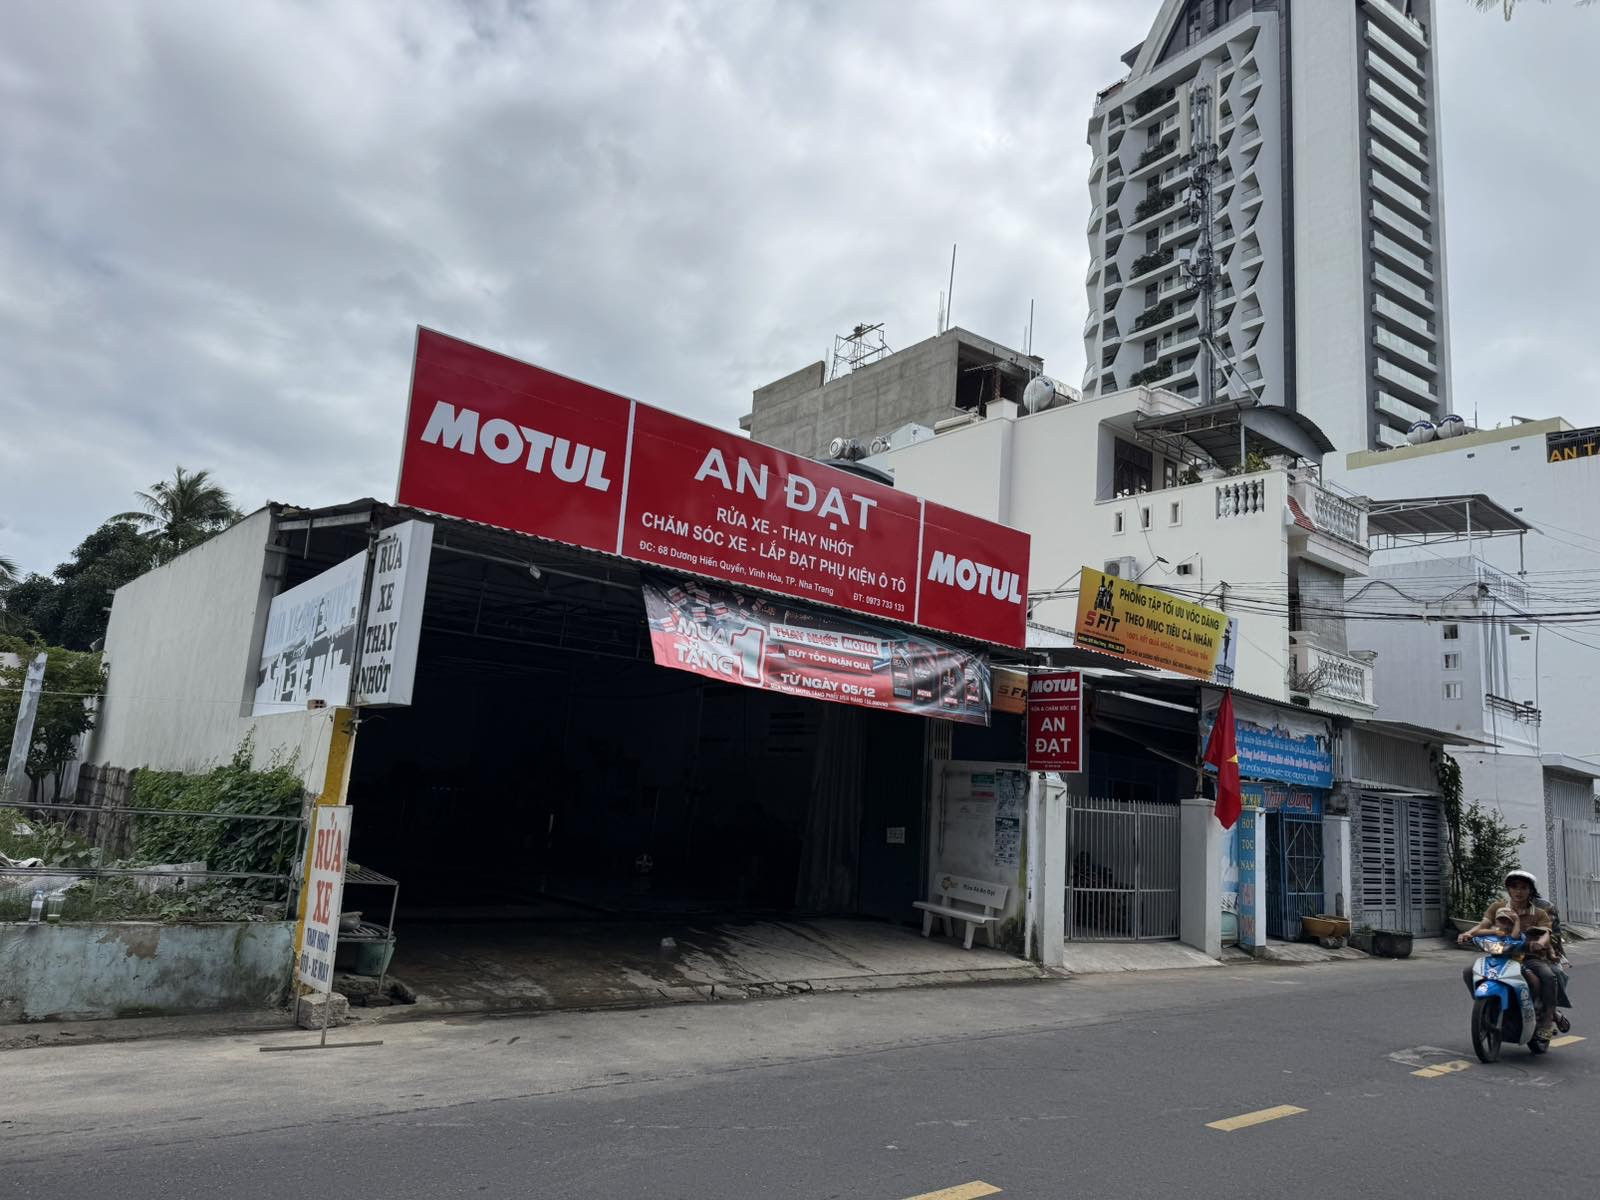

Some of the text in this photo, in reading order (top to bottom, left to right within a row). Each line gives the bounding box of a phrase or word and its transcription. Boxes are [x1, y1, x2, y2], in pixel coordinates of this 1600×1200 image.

[420, 400, 611, 492] MOTUL
[1551, 443, 1600, 461] AN T
[694, 448, 878, 531] AN ĐẠT
[717, 506, 748, 529] RỬA
[751, 516, 770, 535] XE
[781, 525, 817, 547] THAY
[820, 536, 855, 557] NHỚT
[378, 532, 403, 574] RỬA
[639, 540, 656, 553] ĐC:
[657, 546, 668, 556] 68
[670, 549, 698, 565] Dương
[785, 575, 797, 587] TP.
[798, 579, 813, 590] Nha
[814, 583, 834, 597] Trang
[642, 511, 689, 537] CHĂM
[693, 525, 724, 546] SÓC
[728, 534, 748, 552] XE
[759, 540, 786, 561] LẮP
[789, 550, 817, 571] ĐẠT
[819, 559, 845, 580] PHỤ
[848, 566, 876, 587] KIỆN
[878, 572, 889, 589] Ô
[891, 577, 907, 594] TÔ
[927, 550, 1022, 604] MOTUL
[377, 582, 395, 613] XE
[853, 592, 865, 603] ĐT:
[1120, 588, 1147, 607] PHÒNG
[1148, 596, 1161, 613] TẬP
[1163, 599, 1174, 616] TỐI
[1186, 608, 1201, 624] VÓC
[1201, 612, 1220, 631] DÁNG
[365, 621, 398, 655] THAY
[676, 616, 729, 646] MUA
[1085, 610, 1121, 632] S FIT
[1125, 611, 1213, 649] THEO MỤC TIÊU CÁ NHÂN
[674, 634, 736, 677] TẶNG
[788, 647, 806, 660] BỨT
[808, 651, 827, 664] TỐC
[844, 638, 879, 655] MOTUL
[358, 656, 392, 696] NHỚT
[780, 672, 801, 686] TỪ
[802, 677, 838, 692] NGÀY
[841, 683, 877, 699] 05/12
[1031, 679, 1078, 693] MOTUL
[1041, 717, 1065, 732] AN
[1035, 738, 1072, 757] ĐẠT
[315, 811, 342, 873] RỬA
[313, 879, 332, 926] XE
